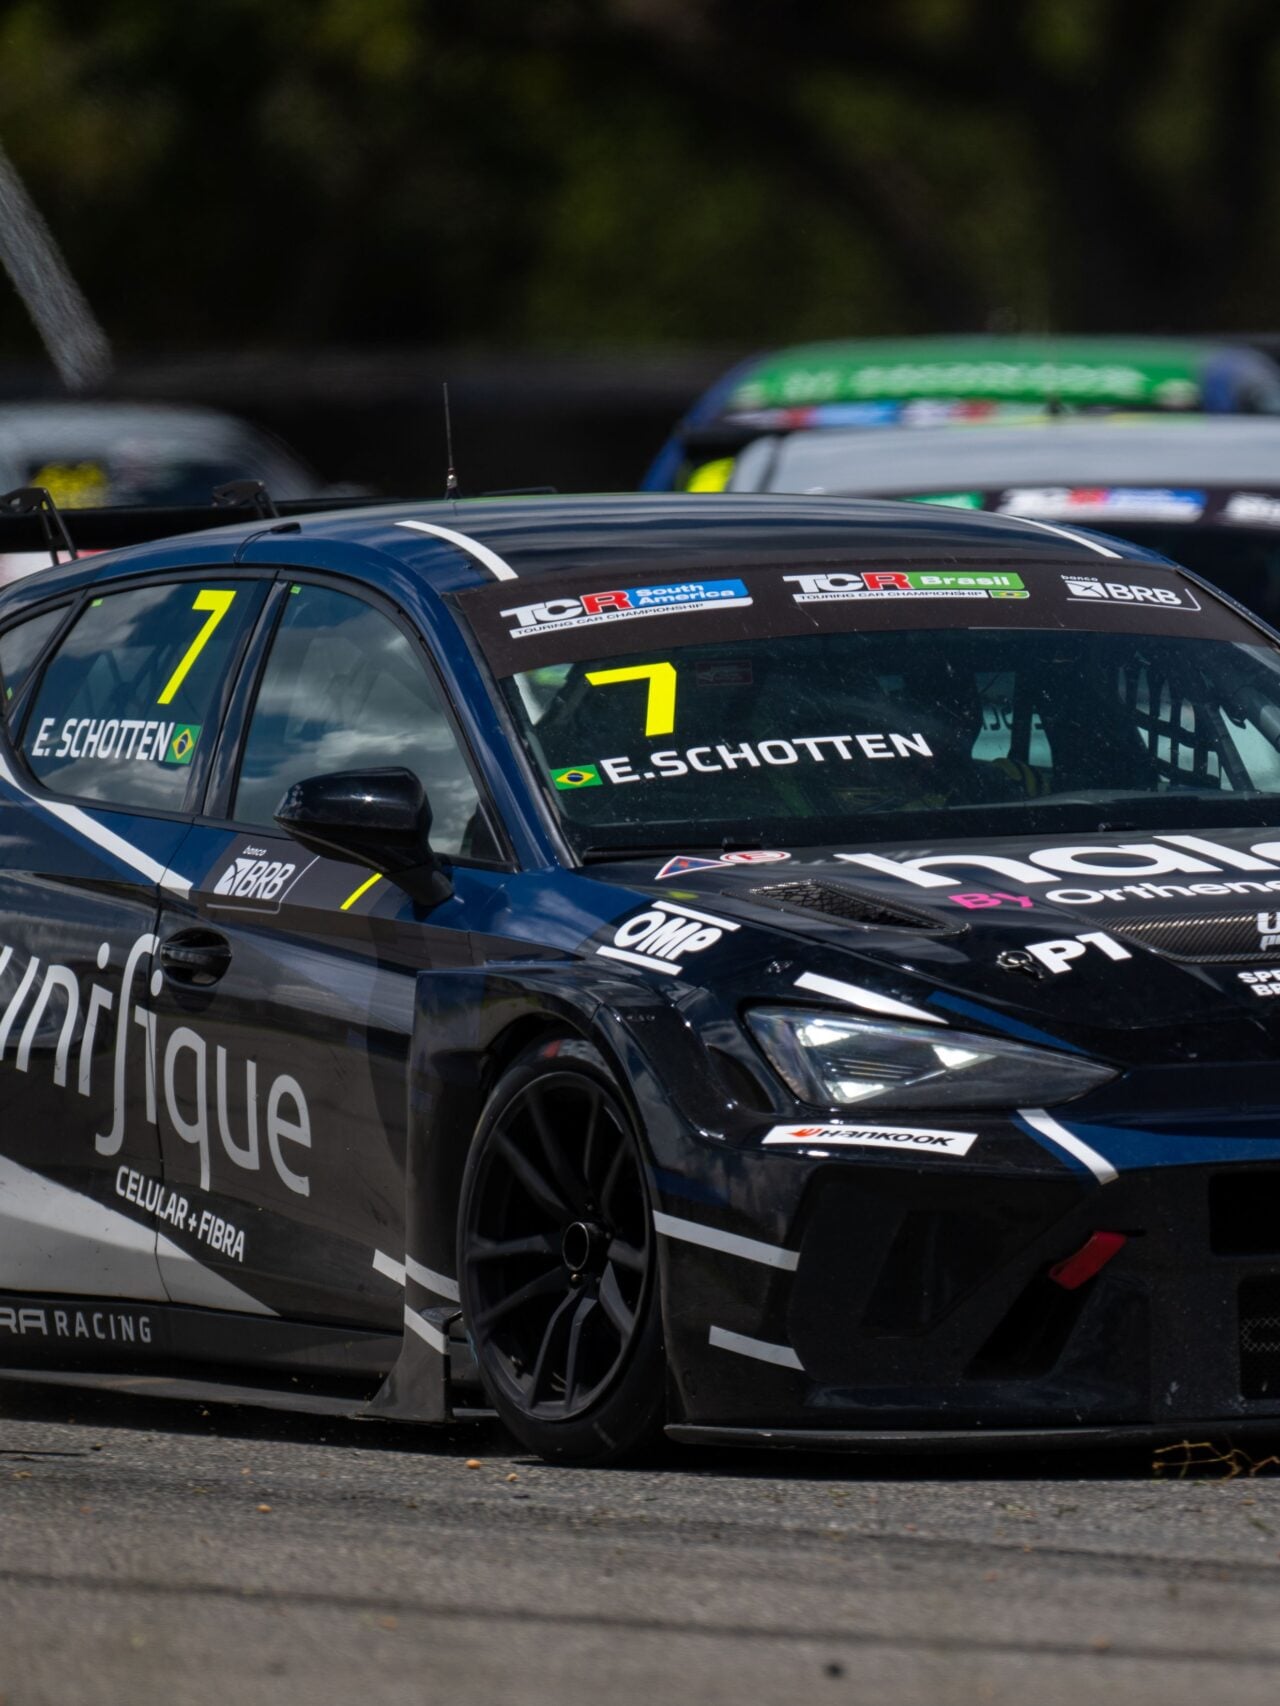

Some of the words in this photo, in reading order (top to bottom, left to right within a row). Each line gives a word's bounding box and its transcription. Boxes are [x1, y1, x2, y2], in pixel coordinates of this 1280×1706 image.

[636, 583, 704, 598] South
[639, 588, 736, 606] America
[782, 571, 916, 593] TCR
[920, 575, 1011, 586] Brasil
[801, 592, 856, 601] TOURING
[887, 590, 983, 599] CHAMPIONSHIP
[1105, 582, 1182, 605] BRB
[500, 590, 634, 628] TCR
[517, 620, 574, 635] TOURING
[577, 615, 604, 625] CAR
[606, 602, 704, 620] CHAMPIONSHIP
[157, 589, 237, 705] 7
[585, 662, 677, 737] 7
[32, 718, 56, 757] E.
[55, 718, 175, 762] SCHOTTEN
[600, 733, 934, 784] E.SCHOTTEN
[235, 860, 296, 900] BRB
[613, 911, 723, 960] OMP
[1025, 931, 1134, 975] P1
[115, 1165, 189, 1230] CELULAR
[188, 1212, 198, 1233] +
[197, 1210, 245, 1263] FIBRA
[53, 1310, 152, 1344] RACING
